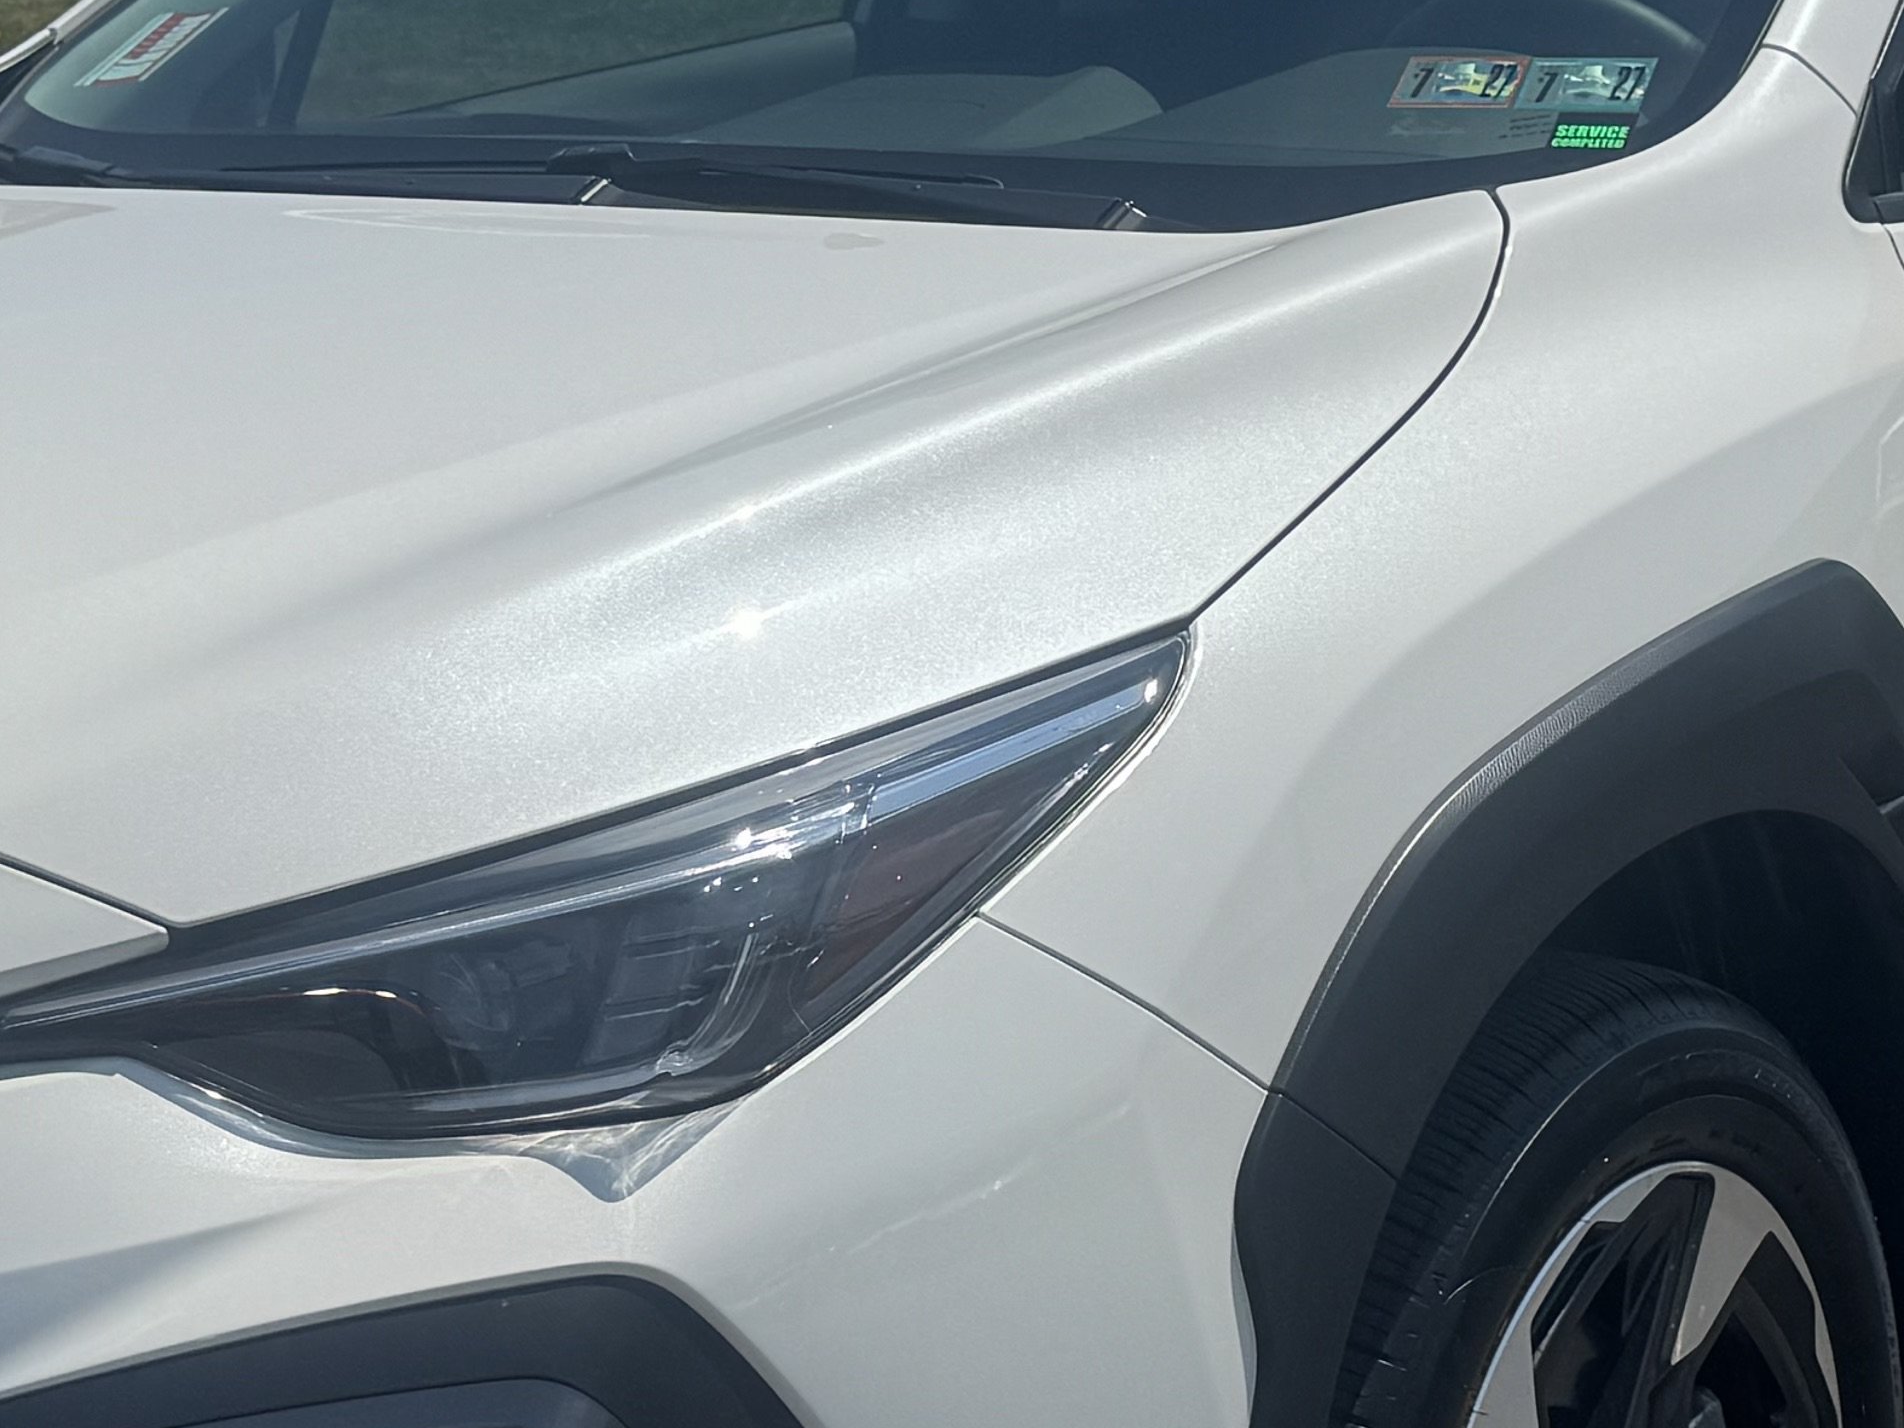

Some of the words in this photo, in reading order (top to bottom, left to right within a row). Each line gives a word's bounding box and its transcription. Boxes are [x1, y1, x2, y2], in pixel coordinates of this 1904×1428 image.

[1479, 63, 1517, 99] 27
[1608, 66, 1647, 102] 27
[1551, 137, 1625, 149] COMPLETED
[1555, 124, 1630, 139] SERVICE
